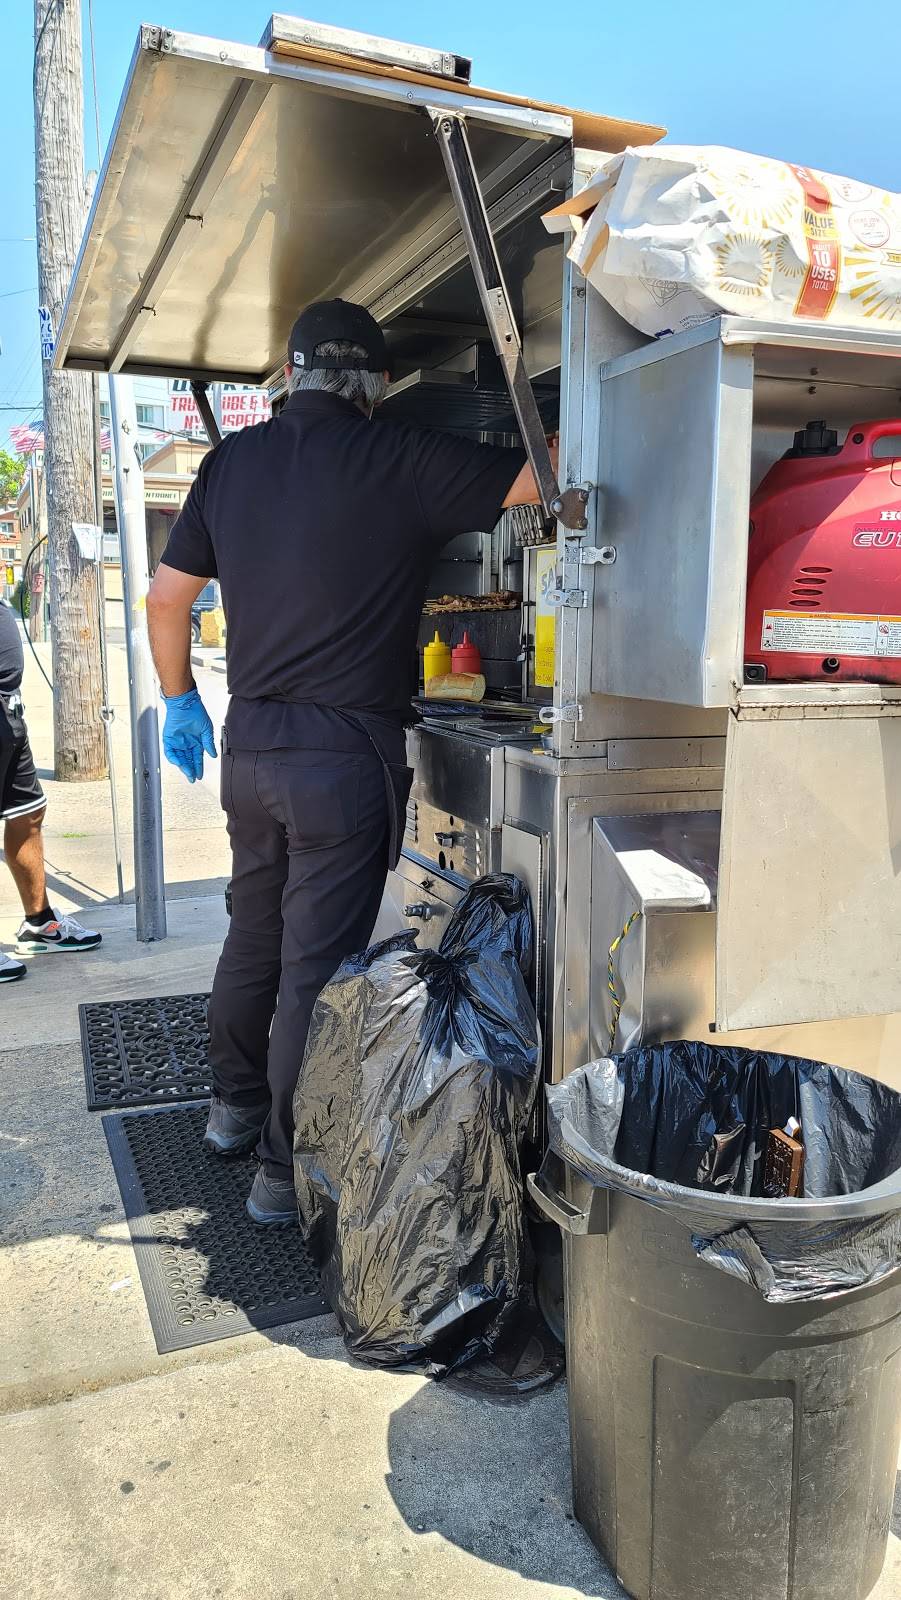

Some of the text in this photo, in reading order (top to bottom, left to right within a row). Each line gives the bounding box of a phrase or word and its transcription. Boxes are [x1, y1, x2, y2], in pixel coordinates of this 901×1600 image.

[804, 210, 834, 229] VALUE
[814, 250, 831, 267] 10
[811, 266, 836, 282] USES
[812, 280, 830, 291] TOTAL
[222, 395, 248, 411] UBE
